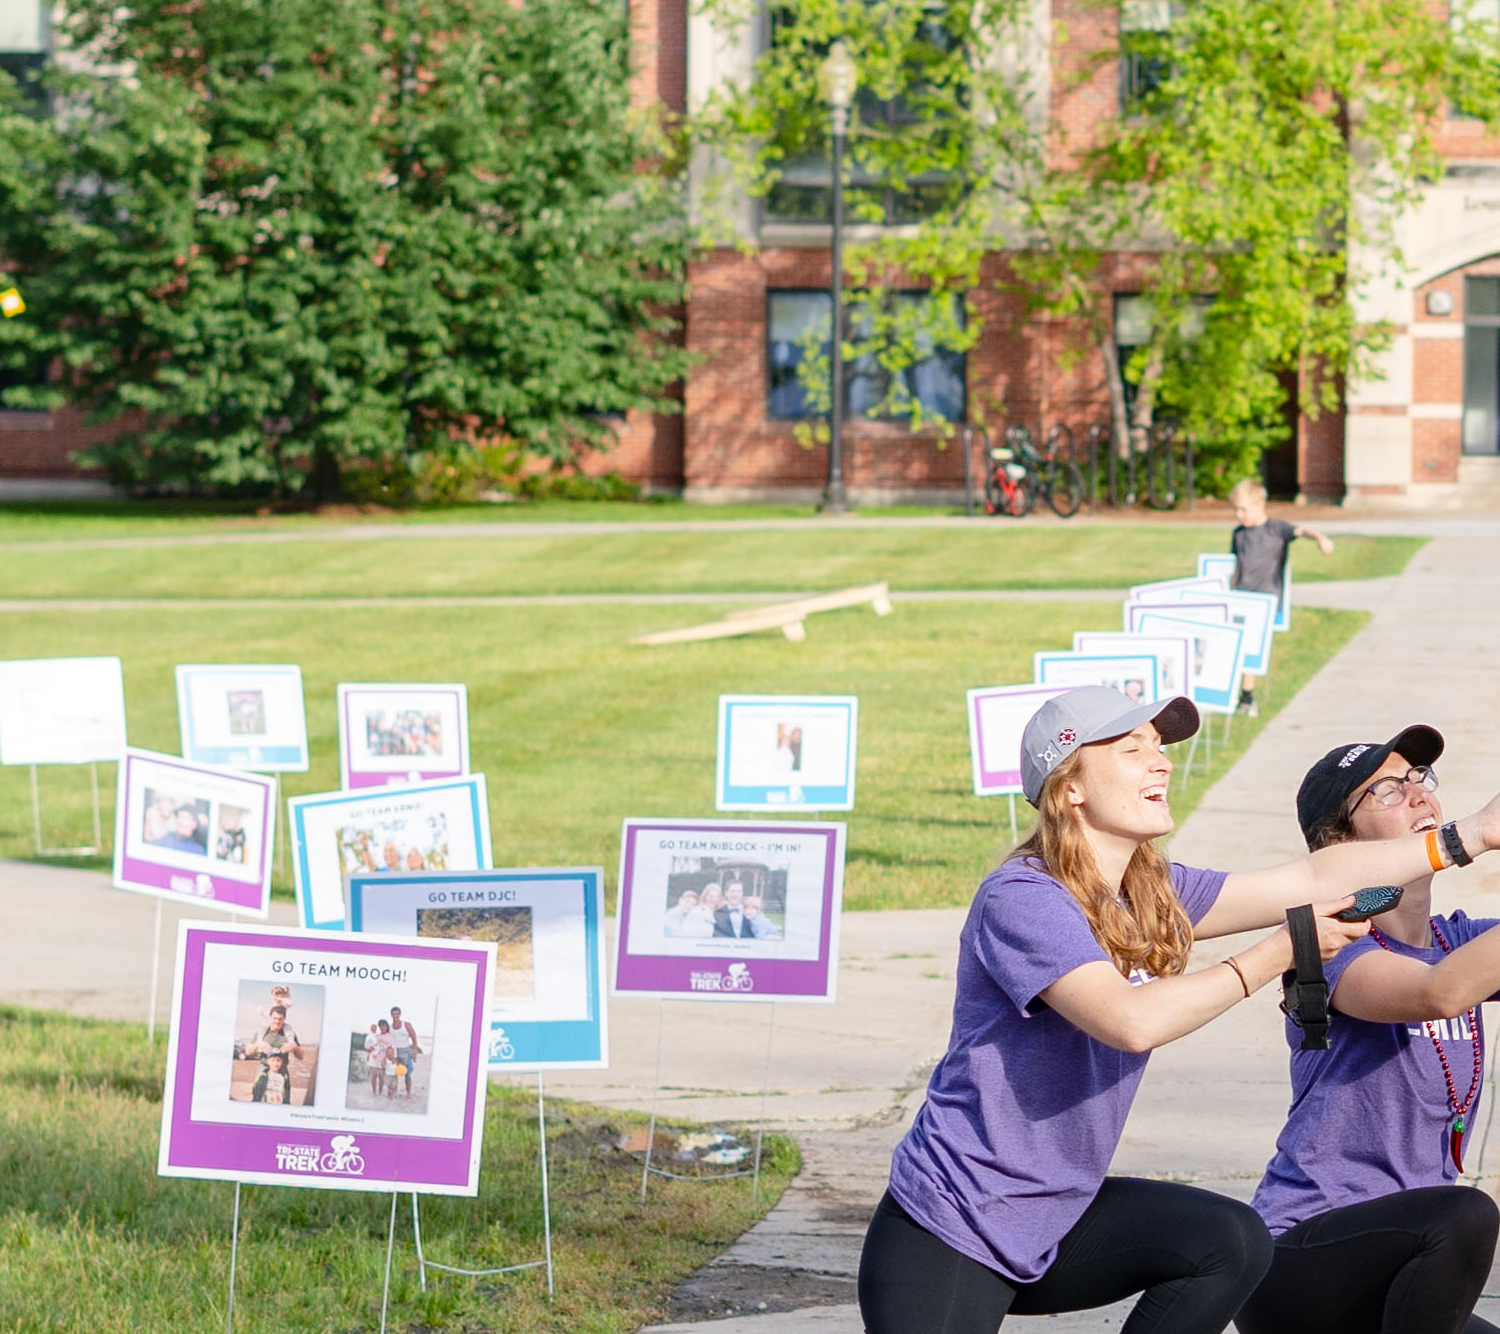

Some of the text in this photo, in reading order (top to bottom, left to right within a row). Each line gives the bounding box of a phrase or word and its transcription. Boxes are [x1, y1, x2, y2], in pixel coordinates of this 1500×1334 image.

[659, 839, 675, 850] GO
[678, 840, 707, 850] TEAM
[710, 841, 757, 852] NIBLOCK
[428, 890, 517, 903] GO TEAM DJC!
[272, 960, 408, 983] GO TEAM MOOCH!
[690, 977, 721, 991] TREK
[276, 1145, 321, 1158] TRI-STATE
[275, 1153, 320, 1172] TREK
